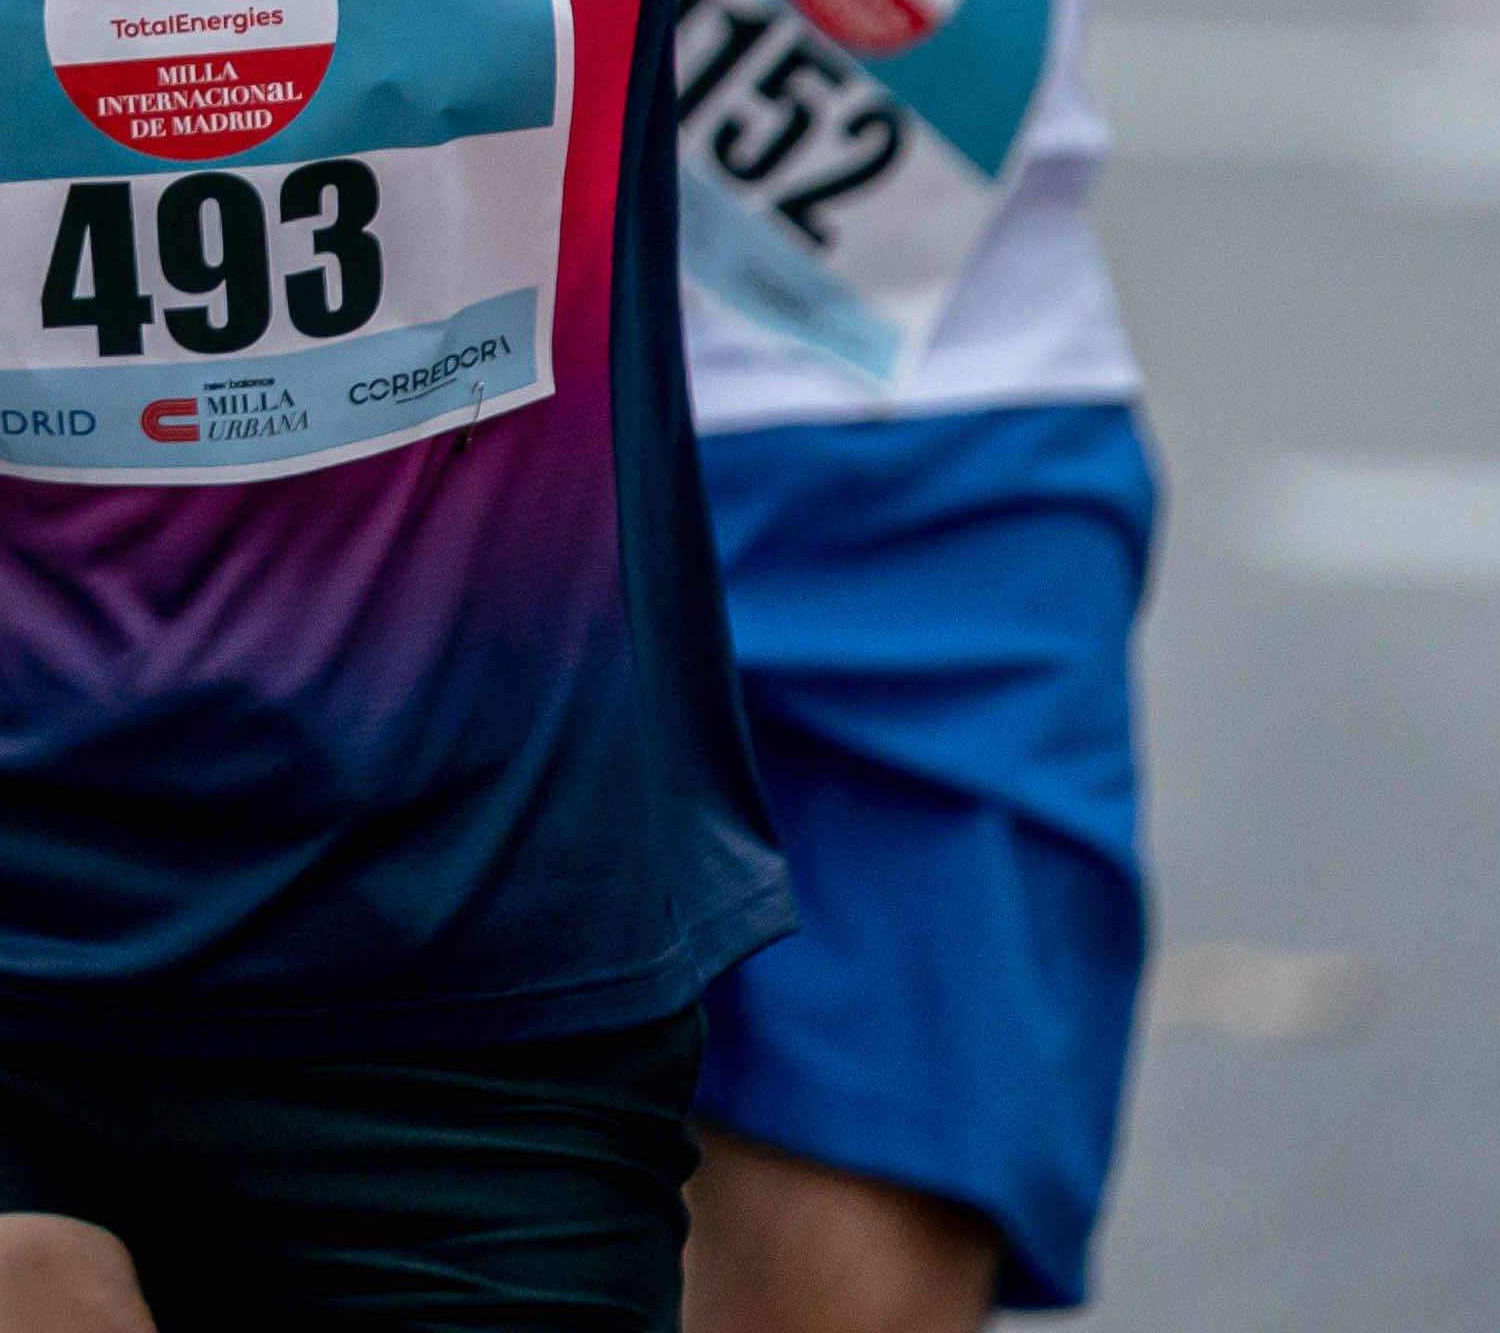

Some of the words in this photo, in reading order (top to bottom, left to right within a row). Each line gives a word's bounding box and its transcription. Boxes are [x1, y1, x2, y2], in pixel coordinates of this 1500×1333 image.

[110, 6, 284, 39] TotalEnergies
[156, 60, 239, 86] MILLA
[130, 118, 167, 139] DE
[171, 108, 274, 136] MADRID
[41, 157, 383, 359] 493
[207, 389, 296, 415] MILLA
[207, 410, 310, 442] URBANA
